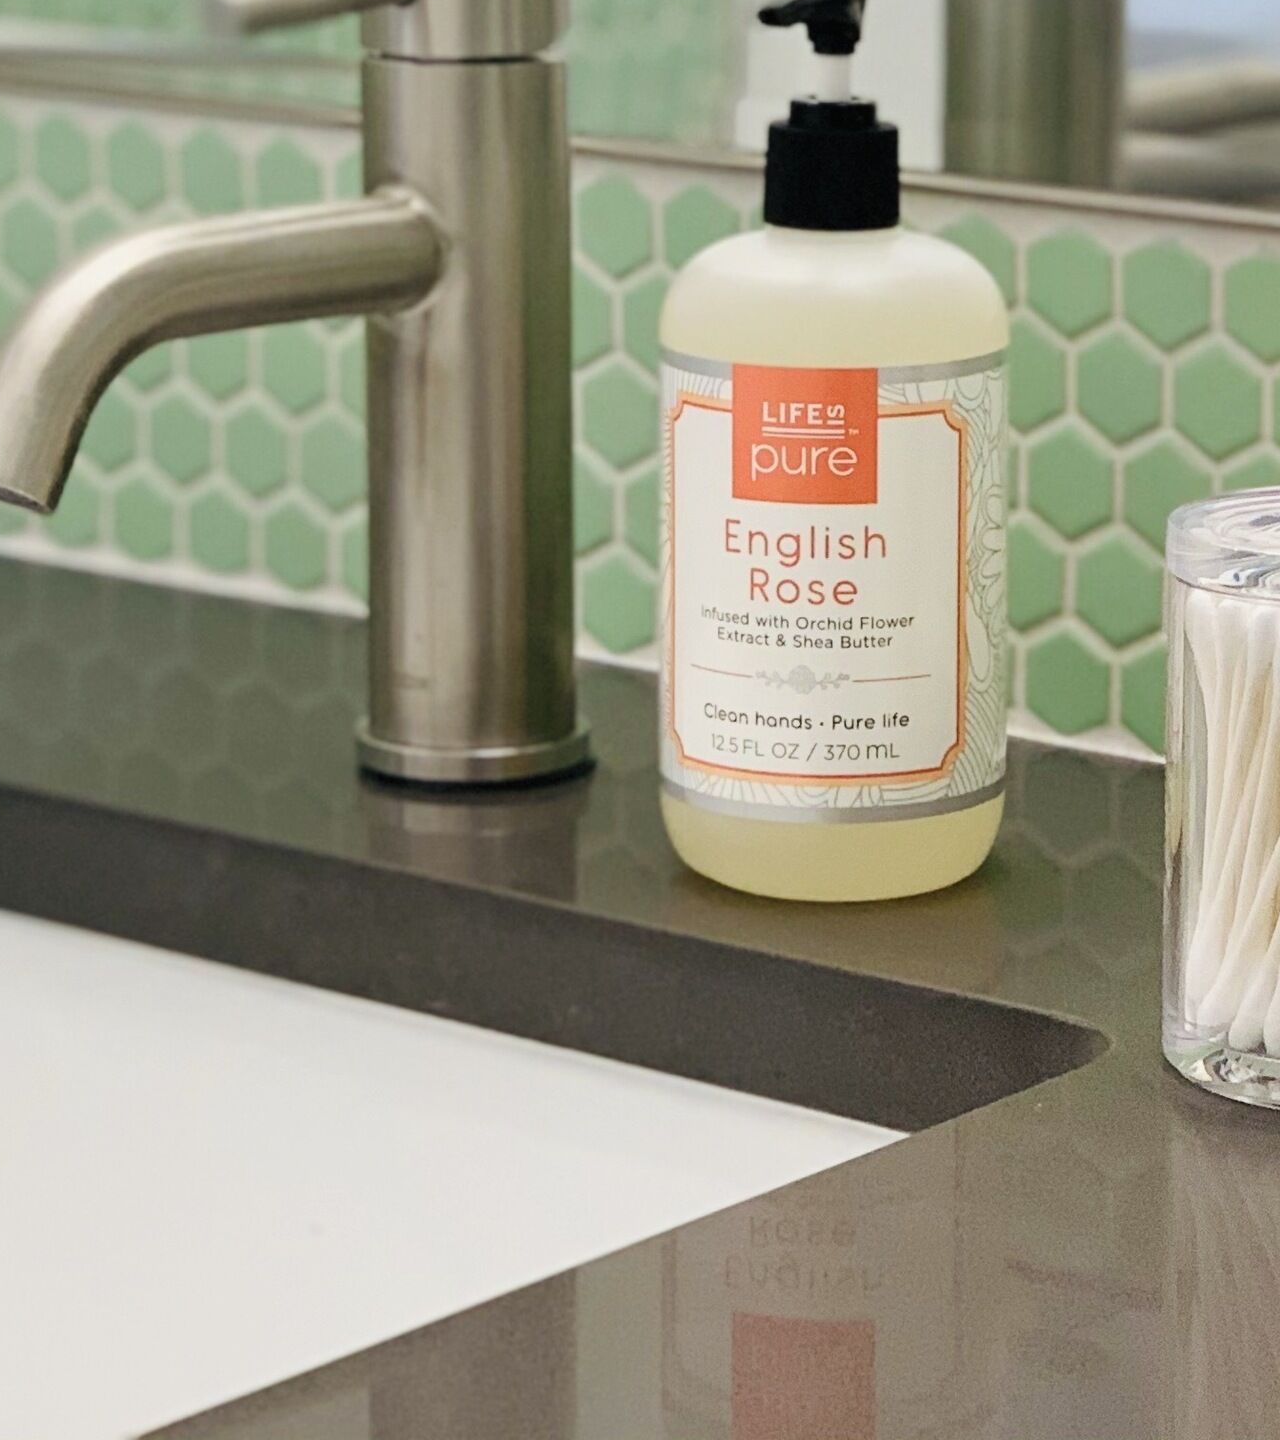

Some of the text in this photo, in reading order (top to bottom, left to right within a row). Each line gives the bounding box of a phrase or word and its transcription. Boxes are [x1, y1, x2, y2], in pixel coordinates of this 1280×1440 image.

[762, 401, 823, 425] LIFE
[751, 443, 858, 481] pure
[725, 518, 887, 567] English
[749, 568, 858, 605] Rose
[701, 604, 915, 631] Infused with Orchid Flower
[717, 626, 894, 649] Extract & Shea Butter
[704, 702, 910, 731] Clean hands Pure life
[771, 742, 800, 760] OZ
[823, 744, 861, 761] 370
[866, 743, 901, 759] mL
